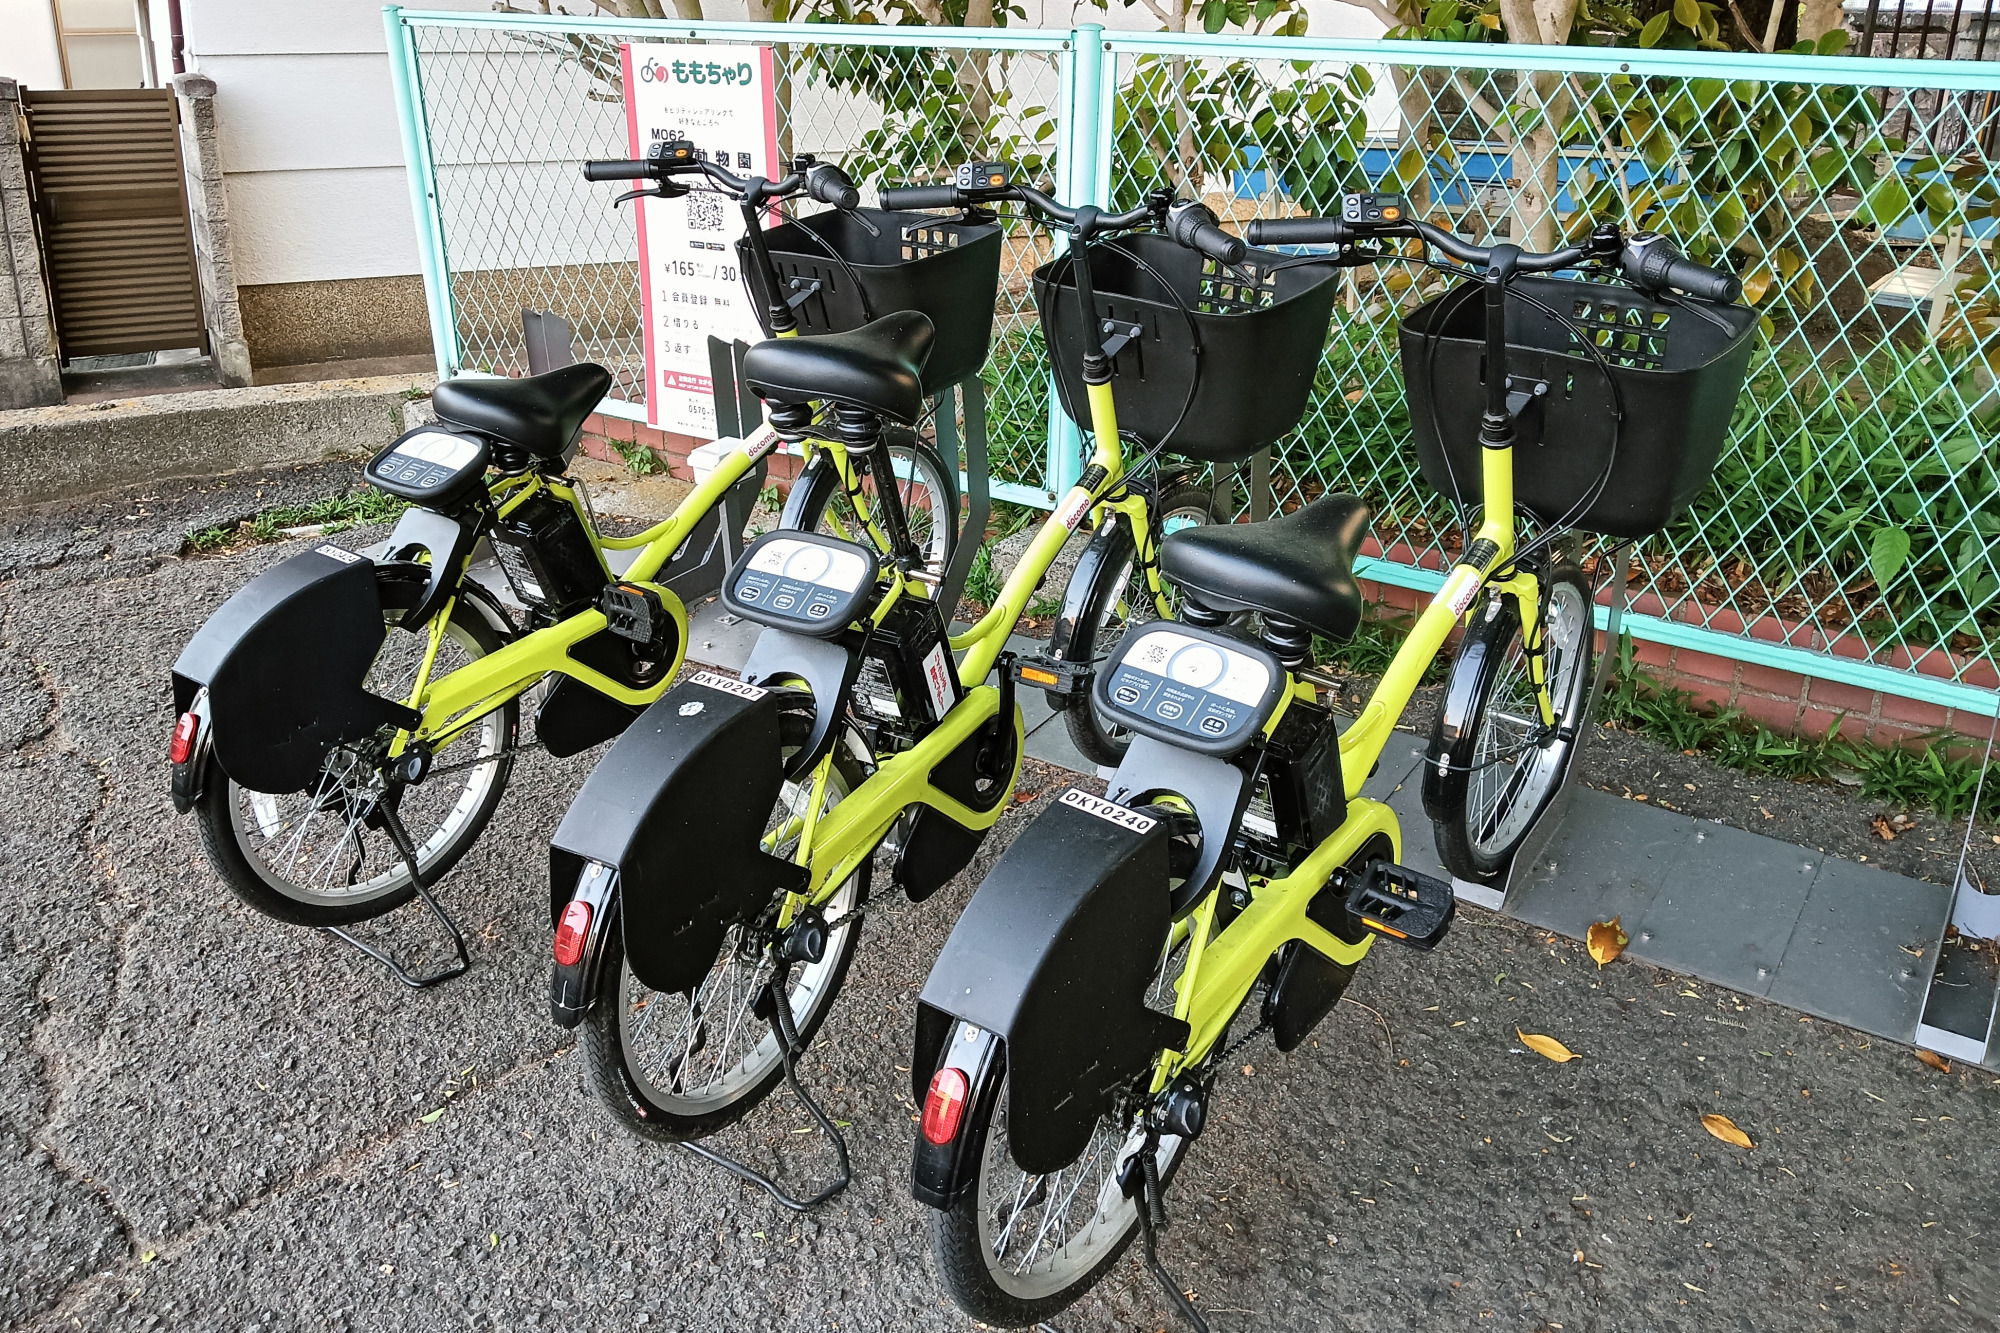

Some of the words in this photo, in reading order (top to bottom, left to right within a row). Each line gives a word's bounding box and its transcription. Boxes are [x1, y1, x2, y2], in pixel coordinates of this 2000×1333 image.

[672, 59, 752, 86] ももちゃり
[662, 290, 667, 302] 1
[672, 291, 707, 306] 会員登録
[663, 315, 669, 327] 2
[673, 317, 699, 330] 借りる
[664, 340, 671, 353] 3
[748, 431, 776, 457] docomo
[1066, 499, 1090, 530] docomo
[1454, 580, 1480, 616] docomo
[694, 673, 764, 698] OKY0207
[1065, 792, 1150, 831] OKY0240
